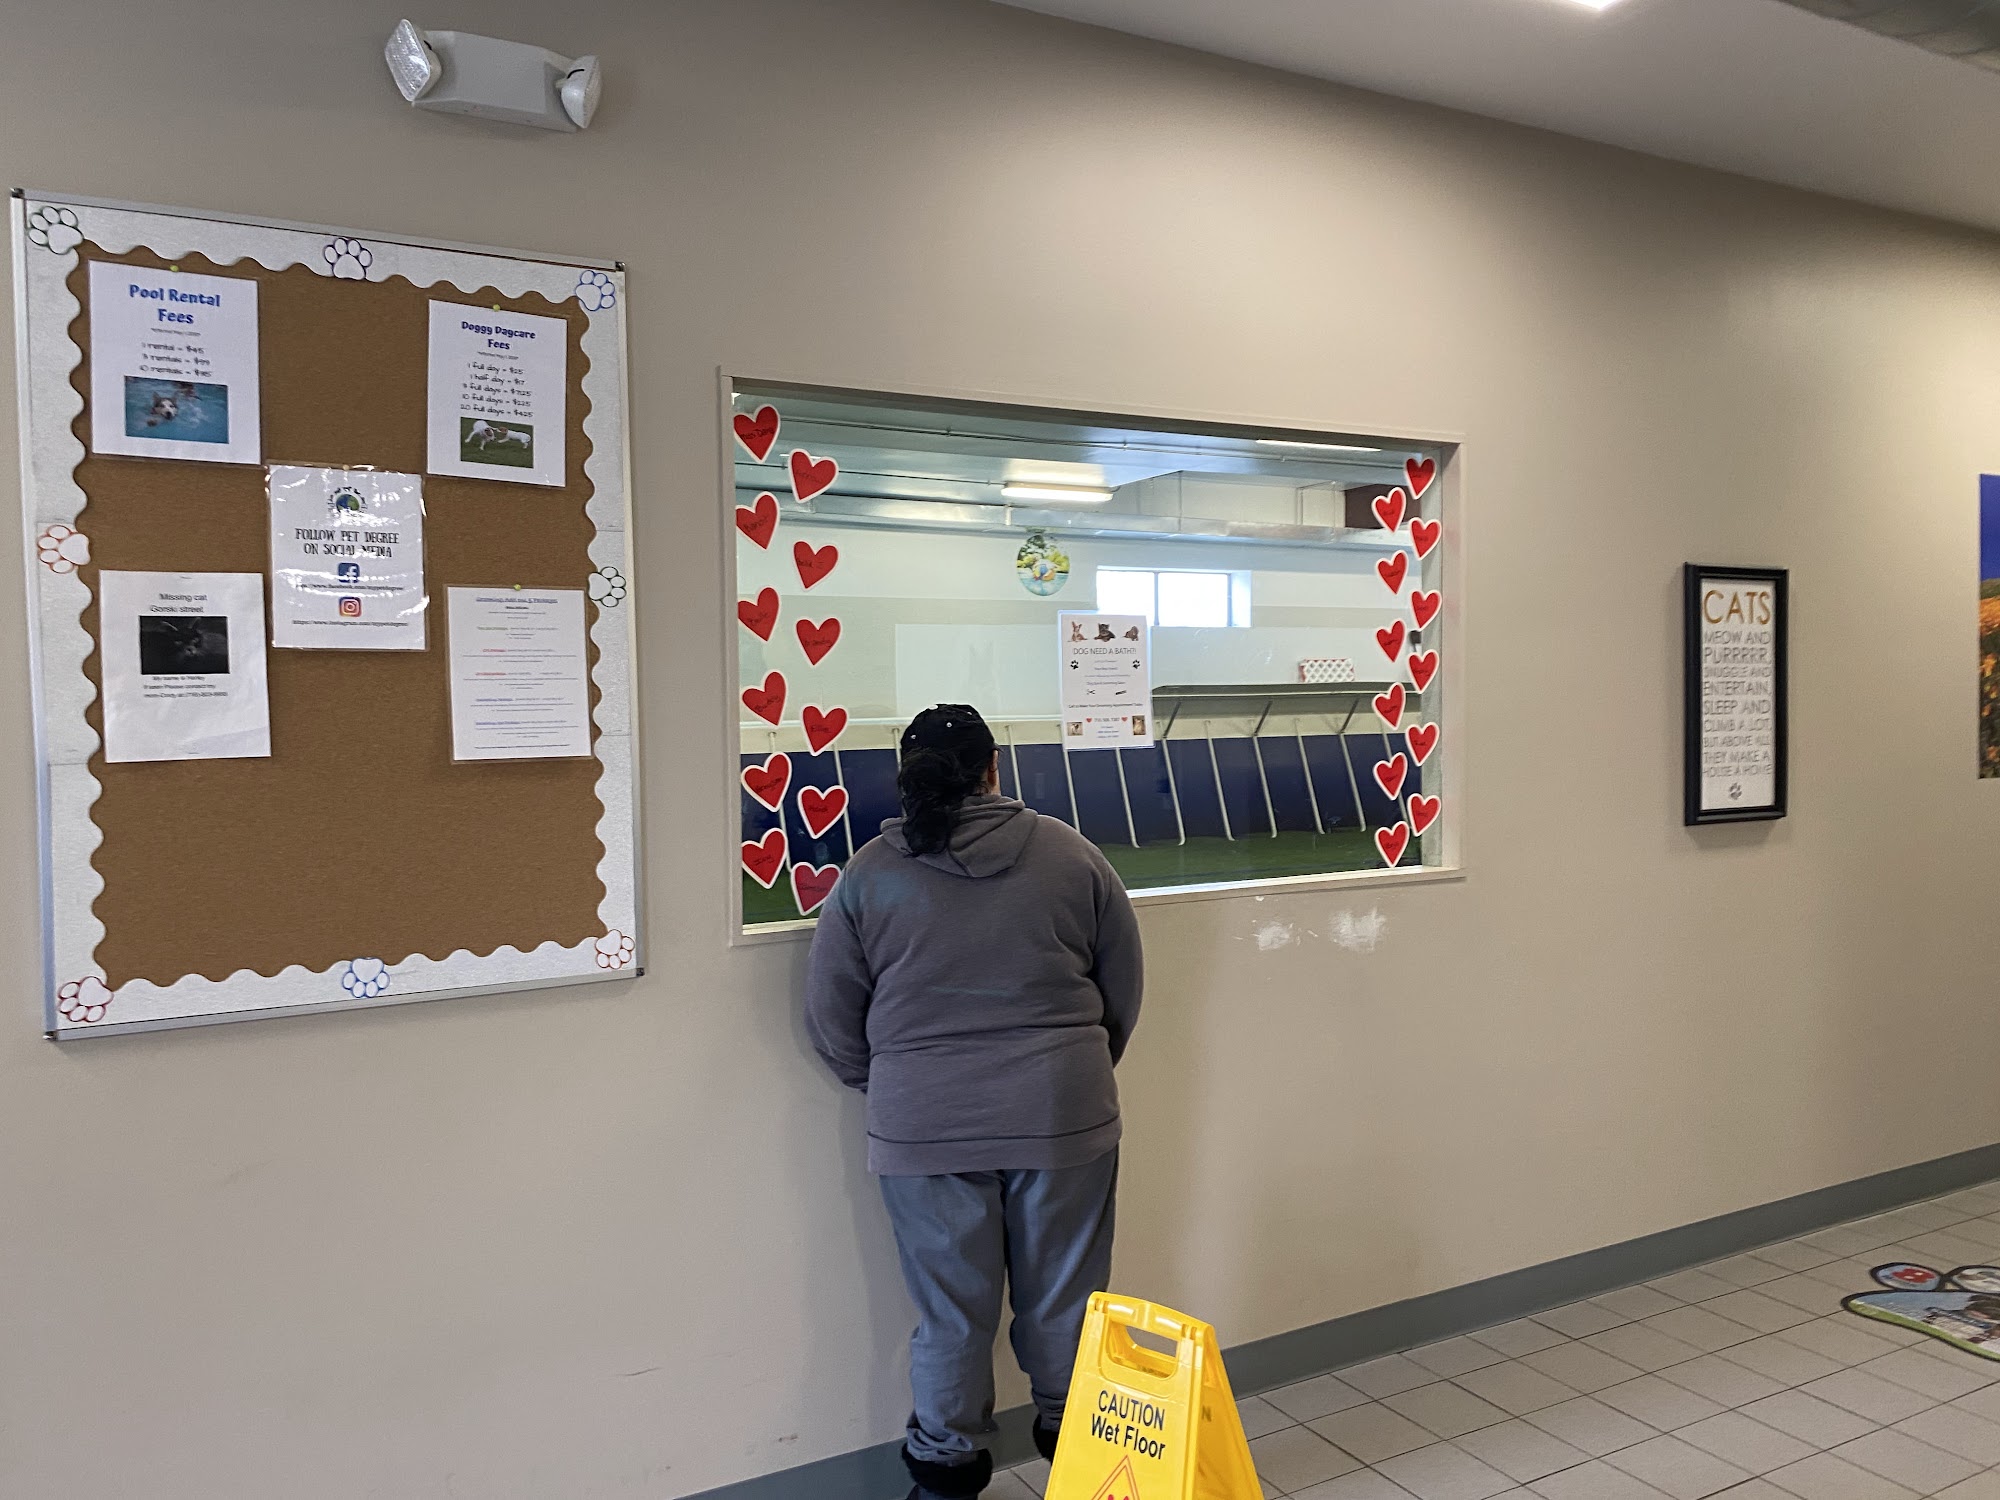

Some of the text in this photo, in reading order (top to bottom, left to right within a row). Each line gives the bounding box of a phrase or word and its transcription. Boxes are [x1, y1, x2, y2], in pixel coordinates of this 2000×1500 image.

[129, 284, 221, 307] Pool Rental
[158, 308, 194, 325] Fees
[461, 321, 536, 340] Doggy Daycare
[488, 339, 510, 349] Fees
[472, 361, 485, 370] full
[487, 364, 500, 375] day
[510, 367, 524, 375] $25
[491, 376, 504, 386] day
[470, 382, 482, 391] full
[484, 385, 501, 396] days
[472, 393, 484, 401] full
[486, 396, 504, 407] days
[473, 403, 485, 412] full
[487, 406, 504, 417] days
[295, 527, 400, 545] FOLLOW PET DEGREE
[303, 542, 319, 556] ON
[322, 543, 355, 557] SOCIAL
[159, 593, 193, 602] Missing
[1703, 589, 1771, 625] CATS
[1703, 630, 1772, 646] MEOW AND
[1073, 647, 1089, 655] DOG
[1090, 647, 1108, 655] NEED
[1750, 666, 1772, 679] AND
[1702, 698, 1772, 716] SLEEP AND
[1738, 719, 1746, 731] A
[1721, 735, 1753, 747] ABOVE
[1701, 749, 1771, 764] THEY MAKE A
[1098, 1389, 1167, 1432] CAUTION
[1091, 1413, 1166, 1460] Wet Floor
